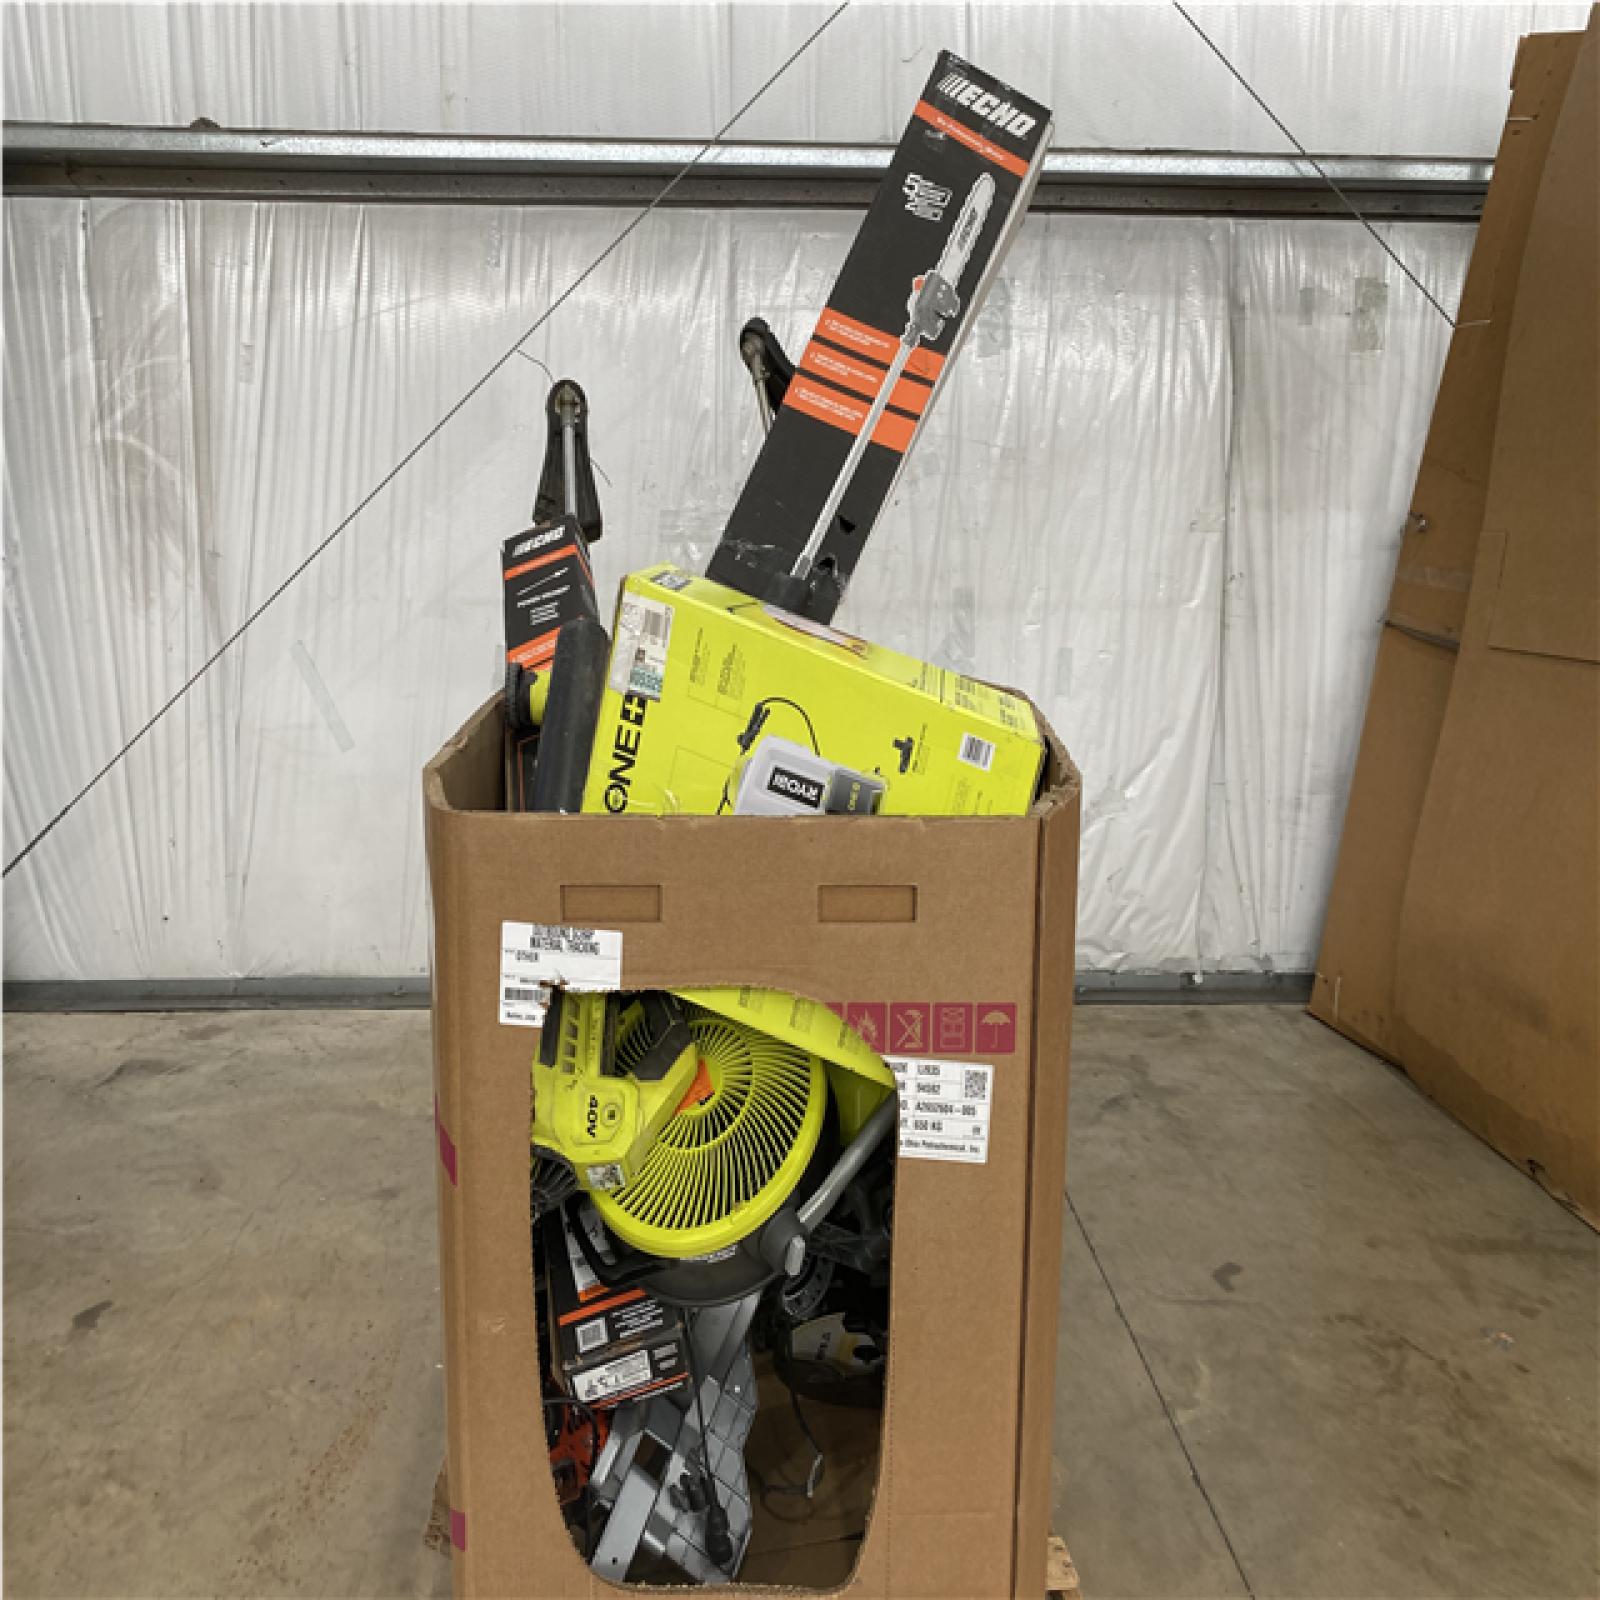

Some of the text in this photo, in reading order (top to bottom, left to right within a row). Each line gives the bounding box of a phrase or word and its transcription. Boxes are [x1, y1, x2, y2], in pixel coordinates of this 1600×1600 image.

[952, 81, 1037, 138] ECHO
[772, 774, 819, 802] RYOBI
[516, 949, 539, 962] OTHER
[529, 936, 600, 955] MATERIAL TRACKING
[586, 1094, 598, 1139] 40V
